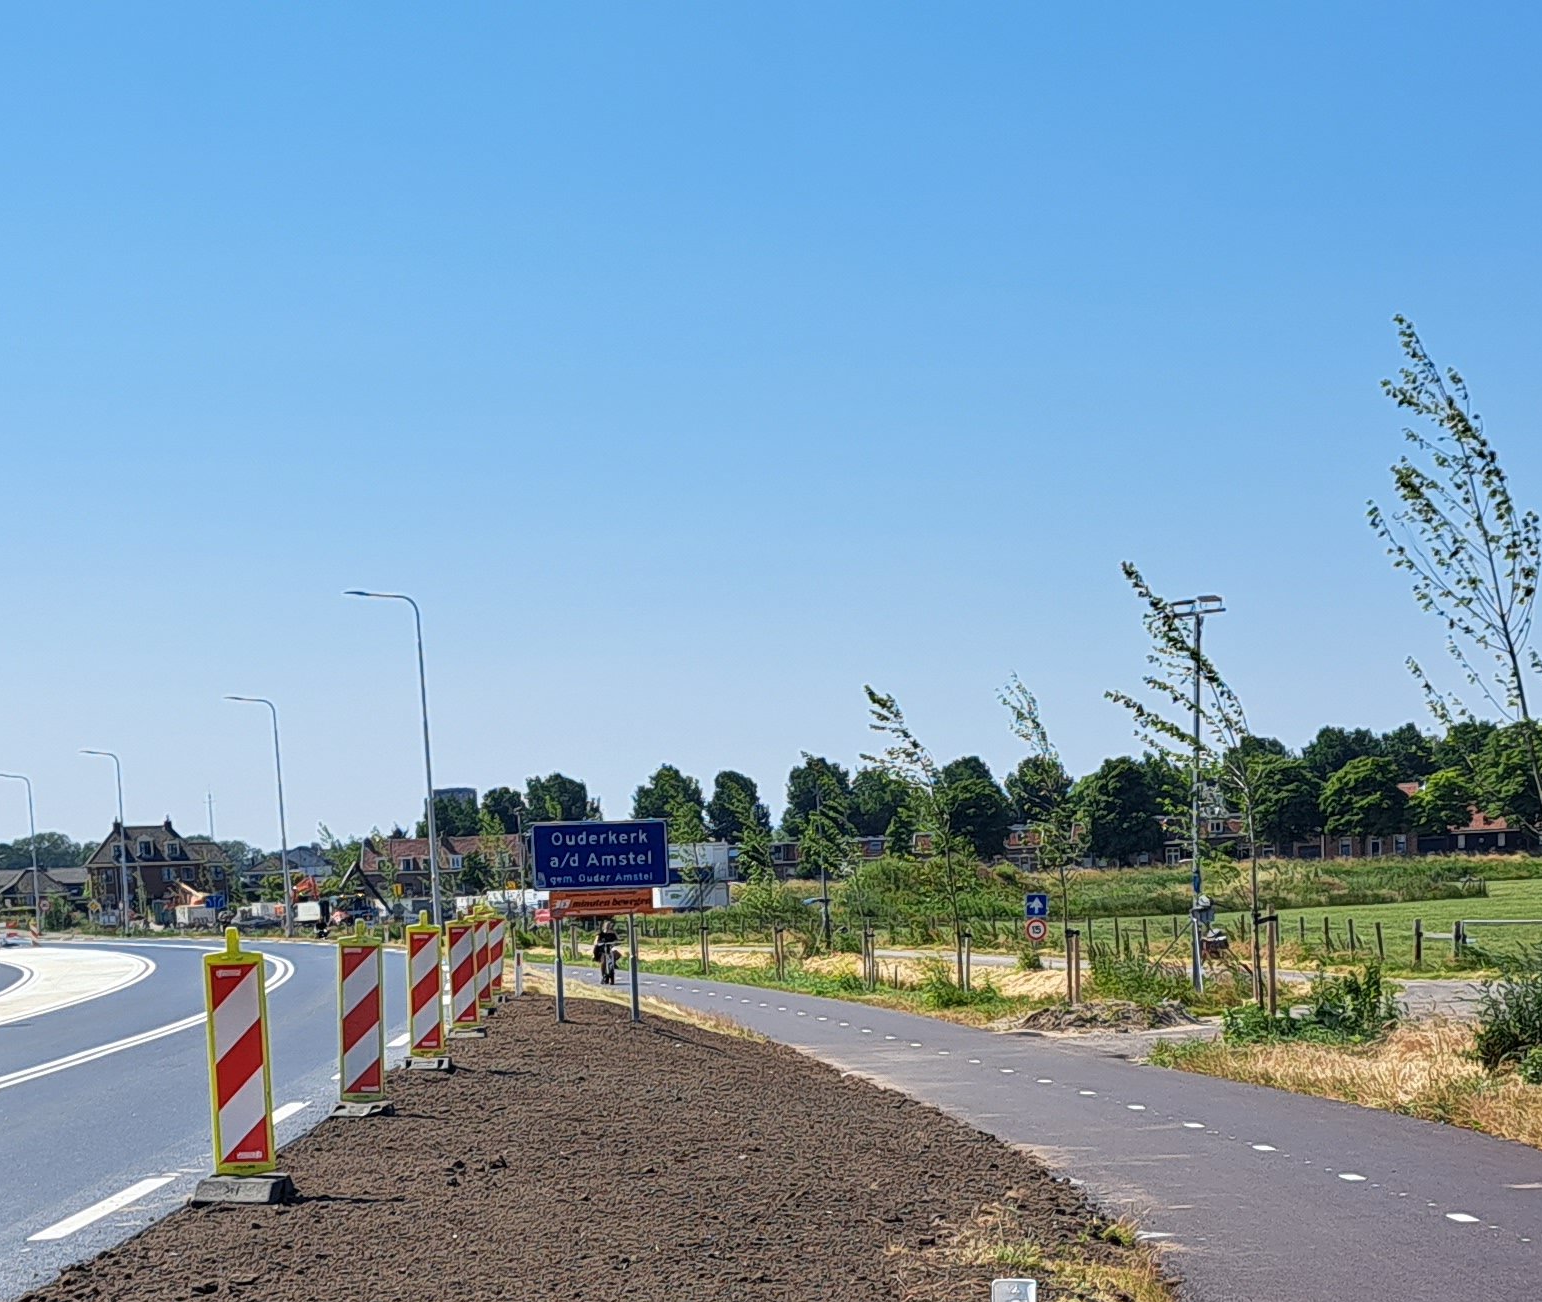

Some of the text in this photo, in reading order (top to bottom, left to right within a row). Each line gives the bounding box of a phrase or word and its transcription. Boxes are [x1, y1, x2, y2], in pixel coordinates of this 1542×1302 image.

[551, 829, 648, 846] Ouderkerk
[549, 850, 652, 869] a/d Amstel
[579, 873, 611, 882] Ouder
[615, 871, 653, 881] Amstel
